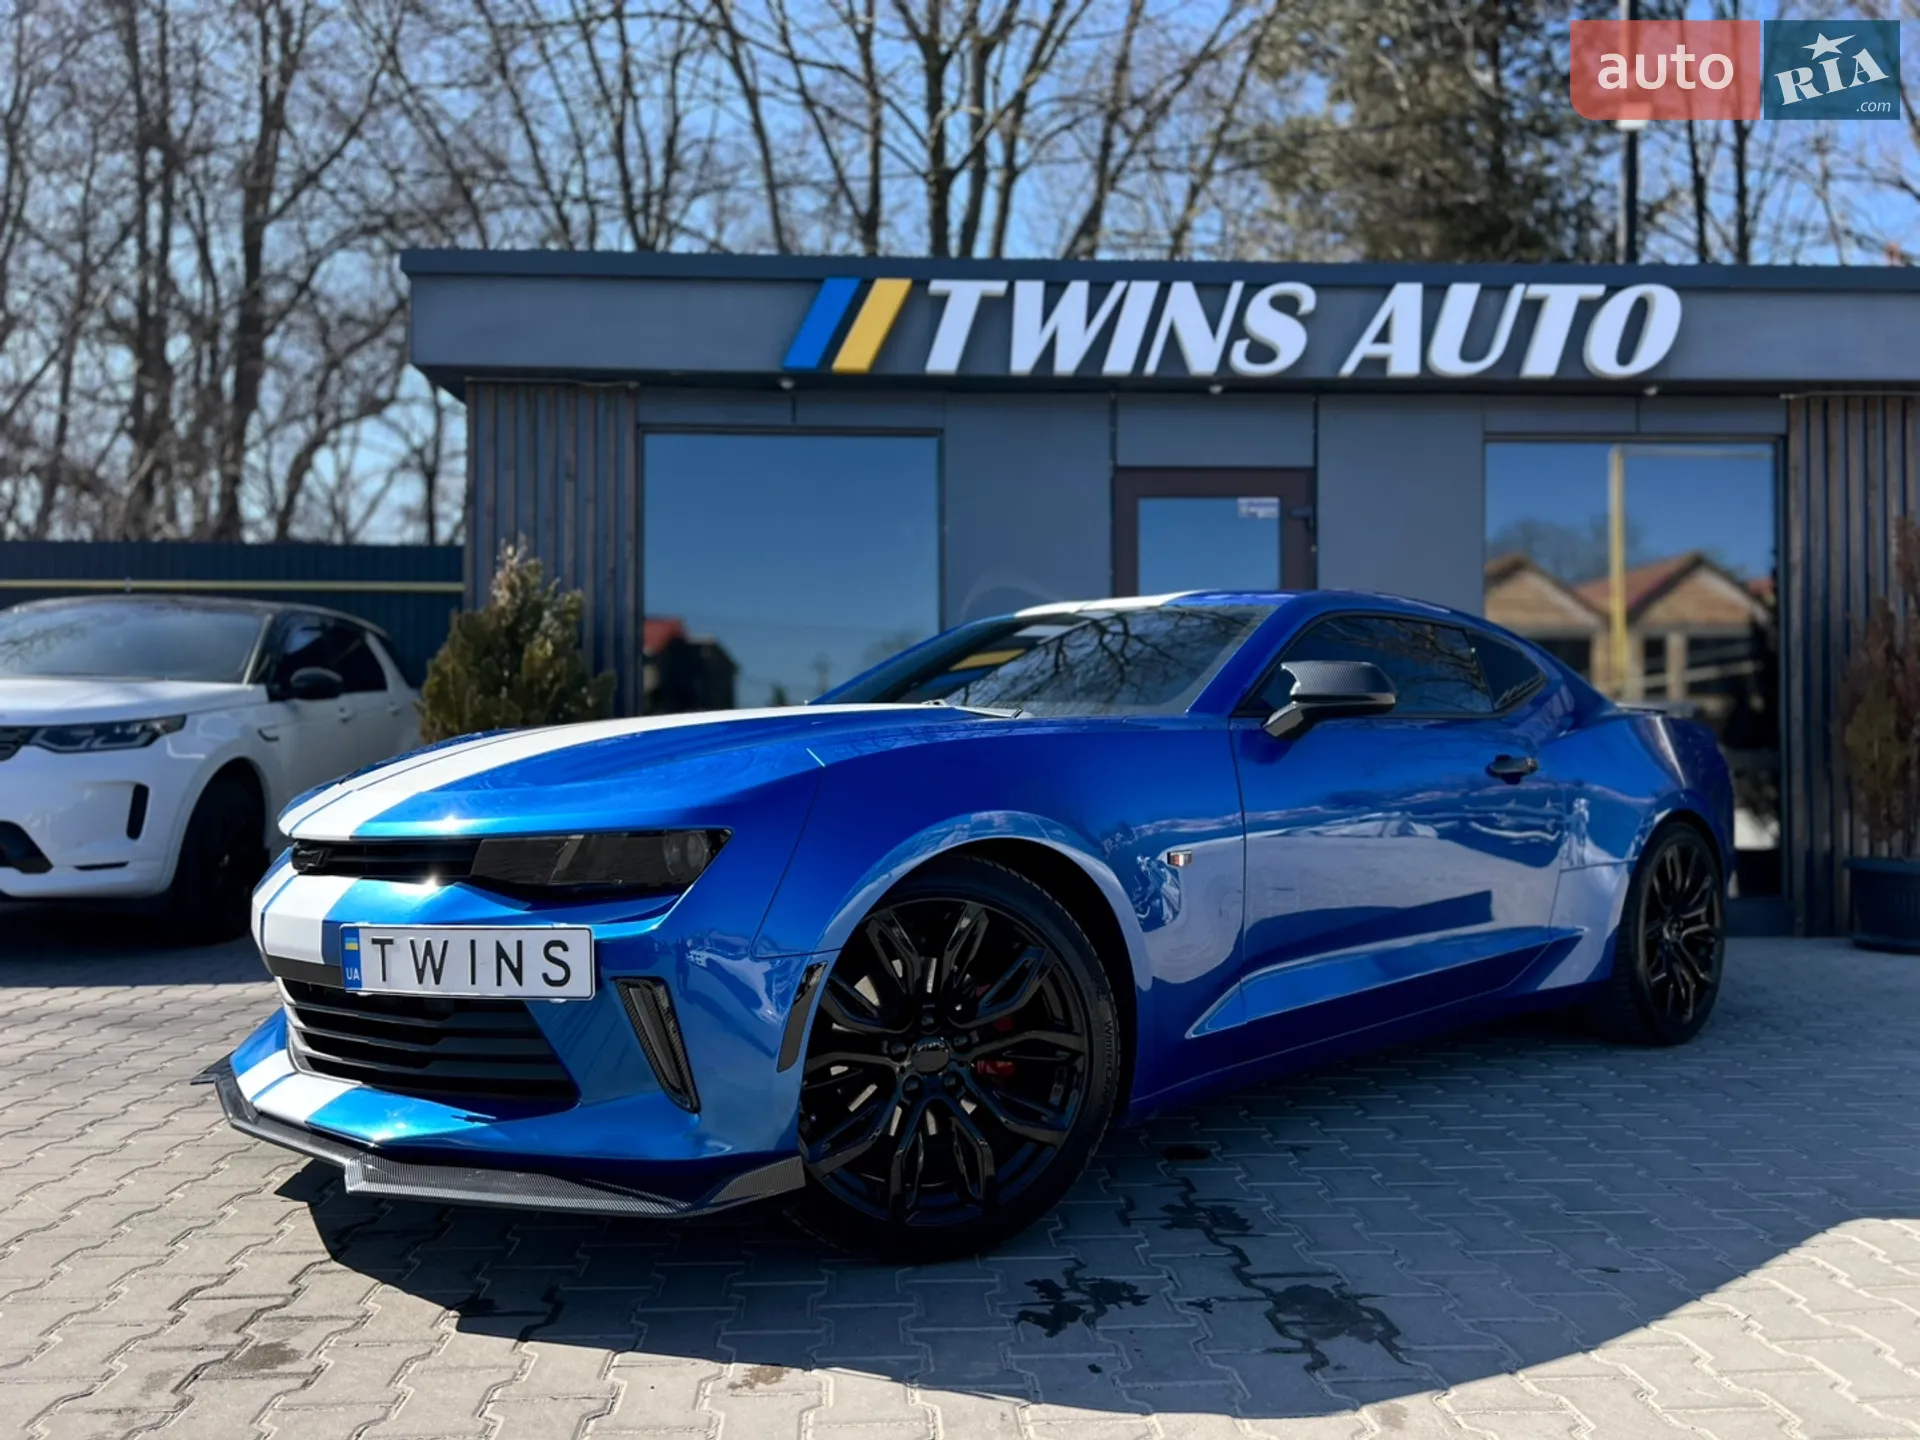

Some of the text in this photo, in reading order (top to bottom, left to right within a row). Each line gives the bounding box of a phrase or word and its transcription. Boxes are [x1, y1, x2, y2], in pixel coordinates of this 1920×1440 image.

[925, 278, 1683, 378] TWINS AUTO
[345, 967, 360, 981] UA
[371, 937, 572, 988] TWINS
